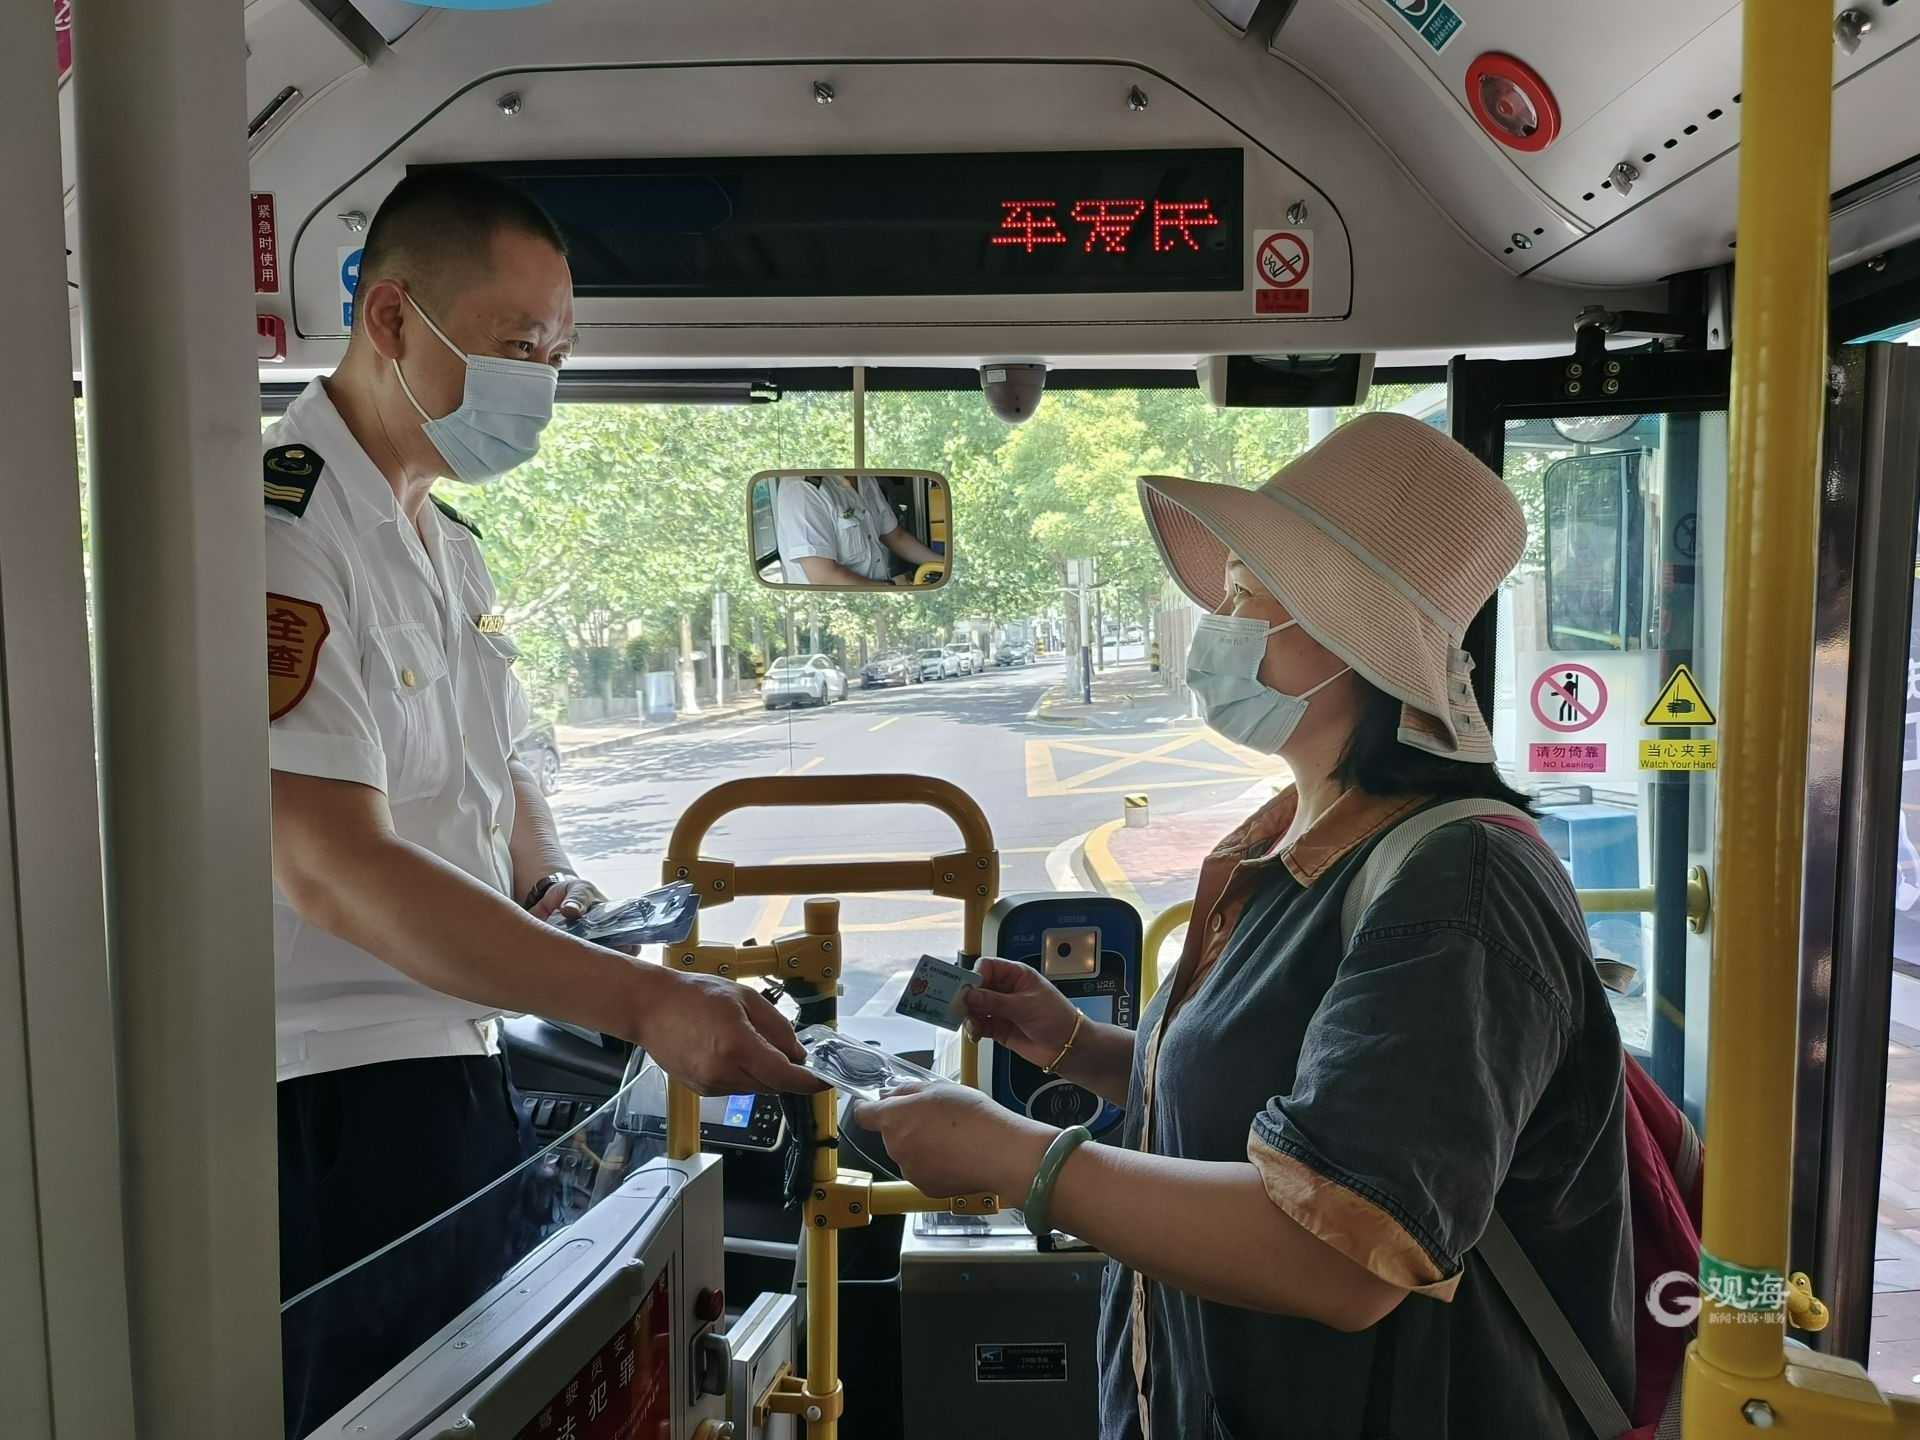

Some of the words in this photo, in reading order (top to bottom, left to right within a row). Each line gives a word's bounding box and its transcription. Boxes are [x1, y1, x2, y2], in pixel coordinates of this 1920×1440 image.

[257, 204, 274, 282] 紧急时使用
[1536, 746, 1598, 758] 请勿倚靠
[1647, 743, 1712, 758] 当心夹手
[1560, 761, 1594, 769] Leaning
[1640, 760, 1668, 769] Watch
[1670, 760, 1691, 769] Your
